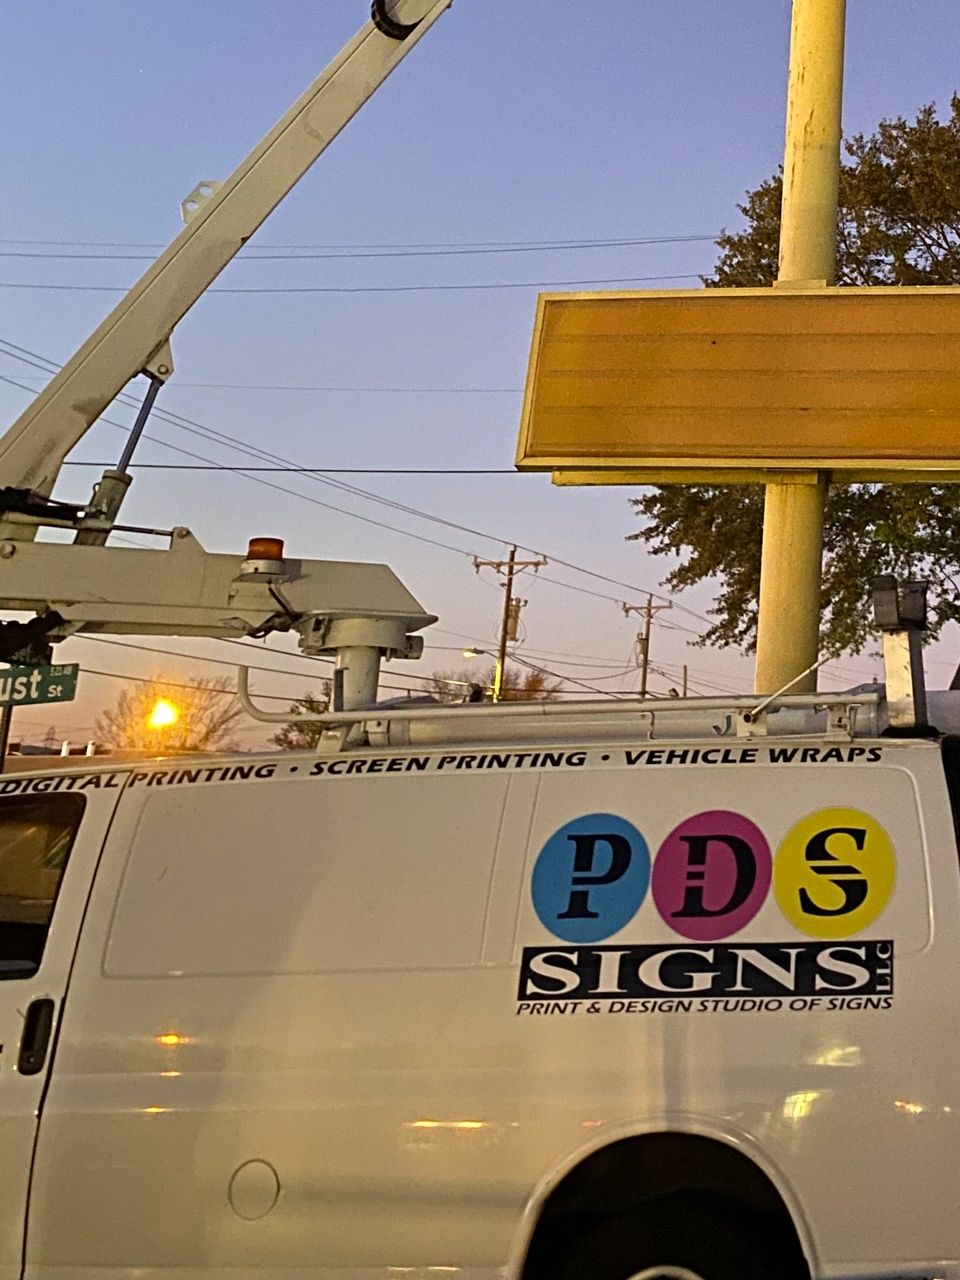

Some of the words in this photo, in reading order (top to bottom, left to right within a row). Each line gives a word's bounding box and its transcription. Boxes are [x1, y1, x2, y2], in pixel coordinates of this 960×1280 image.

[47, 684, 63, 698] St
[0, 773, 119, 795] DIGITAL
[128, 764, 278, 788] PRINTING
[309, 757, 428, 776] SCREEN
[436, 751, 587, 771] PRINTING
[625, 747, 758, 766] VEHICLE
[768, 747, 883, 764] WRAPS
[525, 946, 870, 995] SIGNS
[876, 943, 892, 992] LLC
[516, 1001, 581, 1015] PRINT
[586, 1001, 601, 1014] &
[608, 999, 692, 1014] DESIGN
[696, 998, 781, 1013] STUDIO
[788, 998, 820, 1012] OF
[826, 996, 893, 1011] SIGNS
